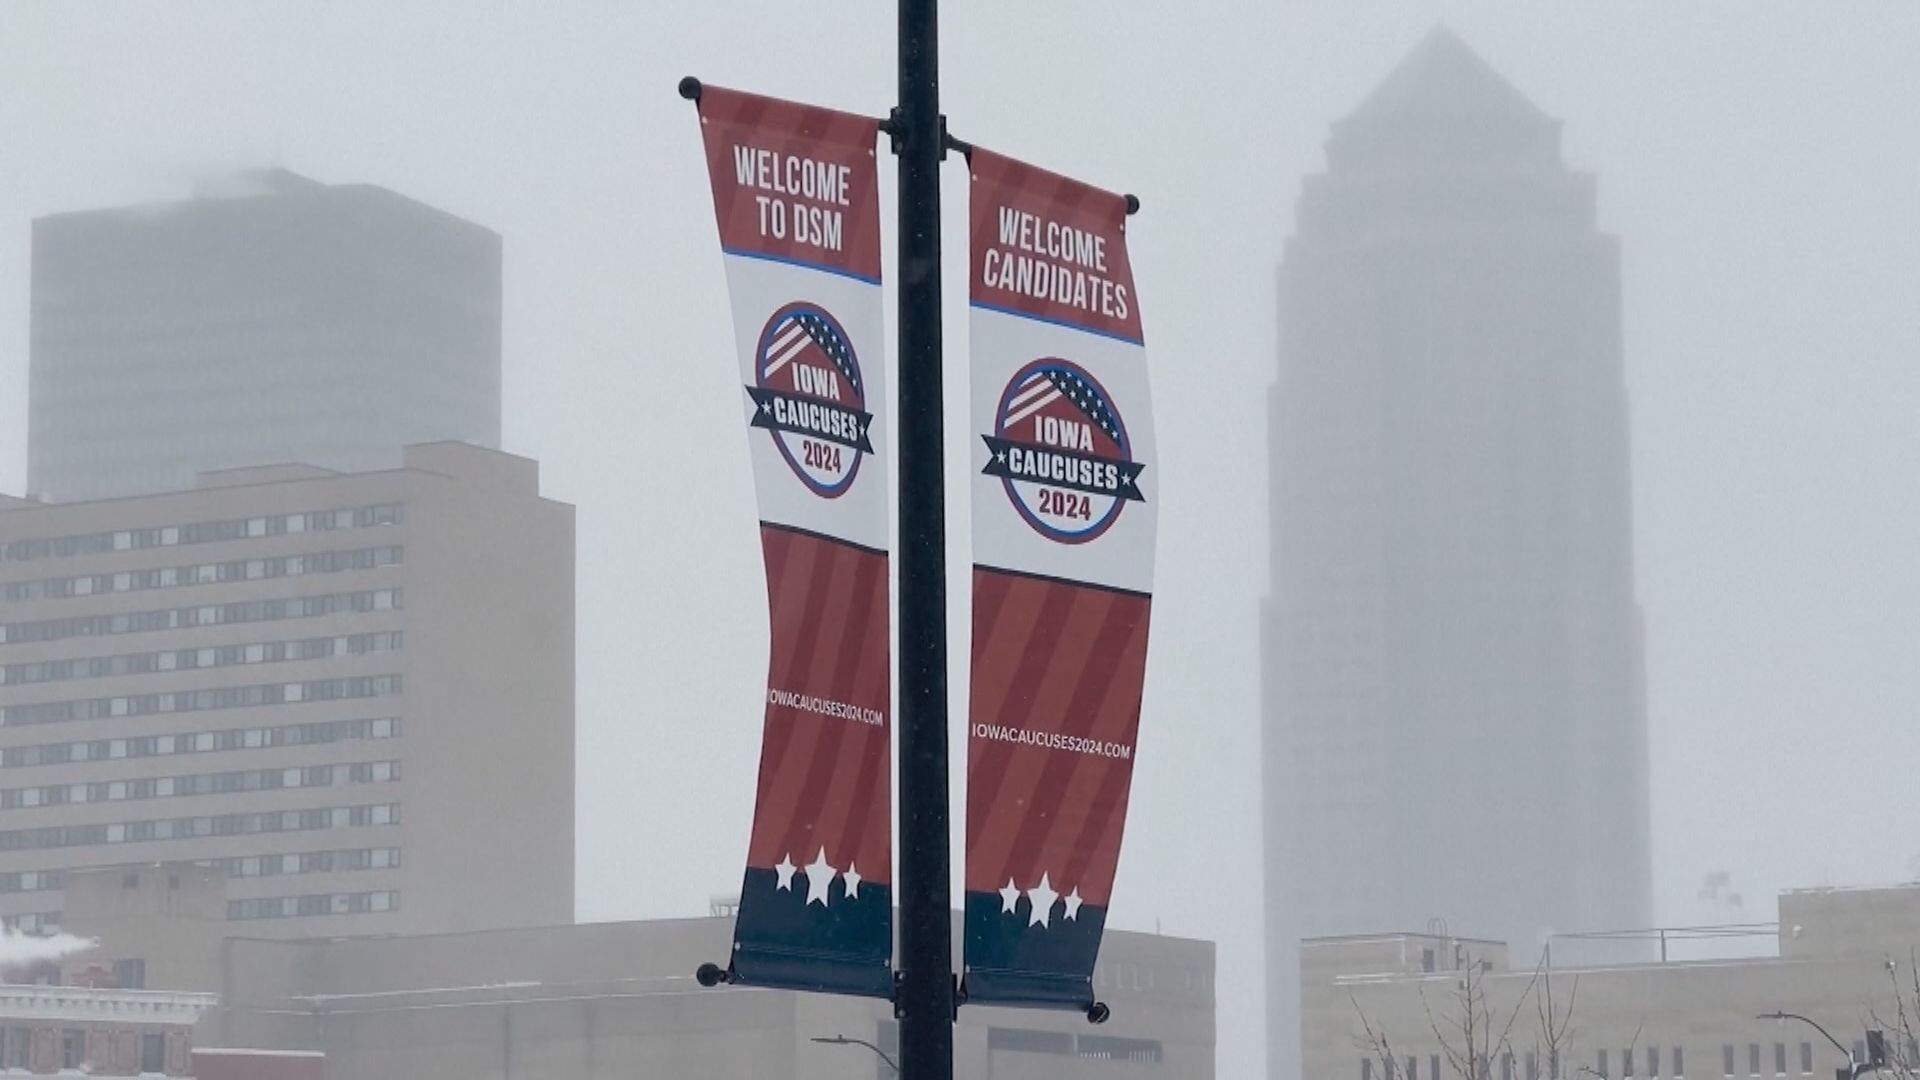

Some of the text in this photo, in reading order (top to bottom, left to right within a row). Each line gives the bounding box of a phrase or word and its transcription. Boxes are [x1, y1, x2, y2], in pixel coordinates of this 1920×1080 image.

[733, 144, 851, 206] WELCOME
[755, 196, 842, 251] TO DSM
[999, 206, 1107, 273] WELCOME
[983, 248, 1128, 319] CANDIDATES
[791, 361, 840, 400] IOWA
[773, 396, 858, 442] CAUCUSES
[1034, 414, 1094, 452] IOWA
[803, 439, 841, 473] 2024
[1008, 448, 1118, 489] CAUCUSES
[1039, 488, 1091, 521] 2024
[972, 723, 1131, 760] IOWACAUCUSES2024.COM
